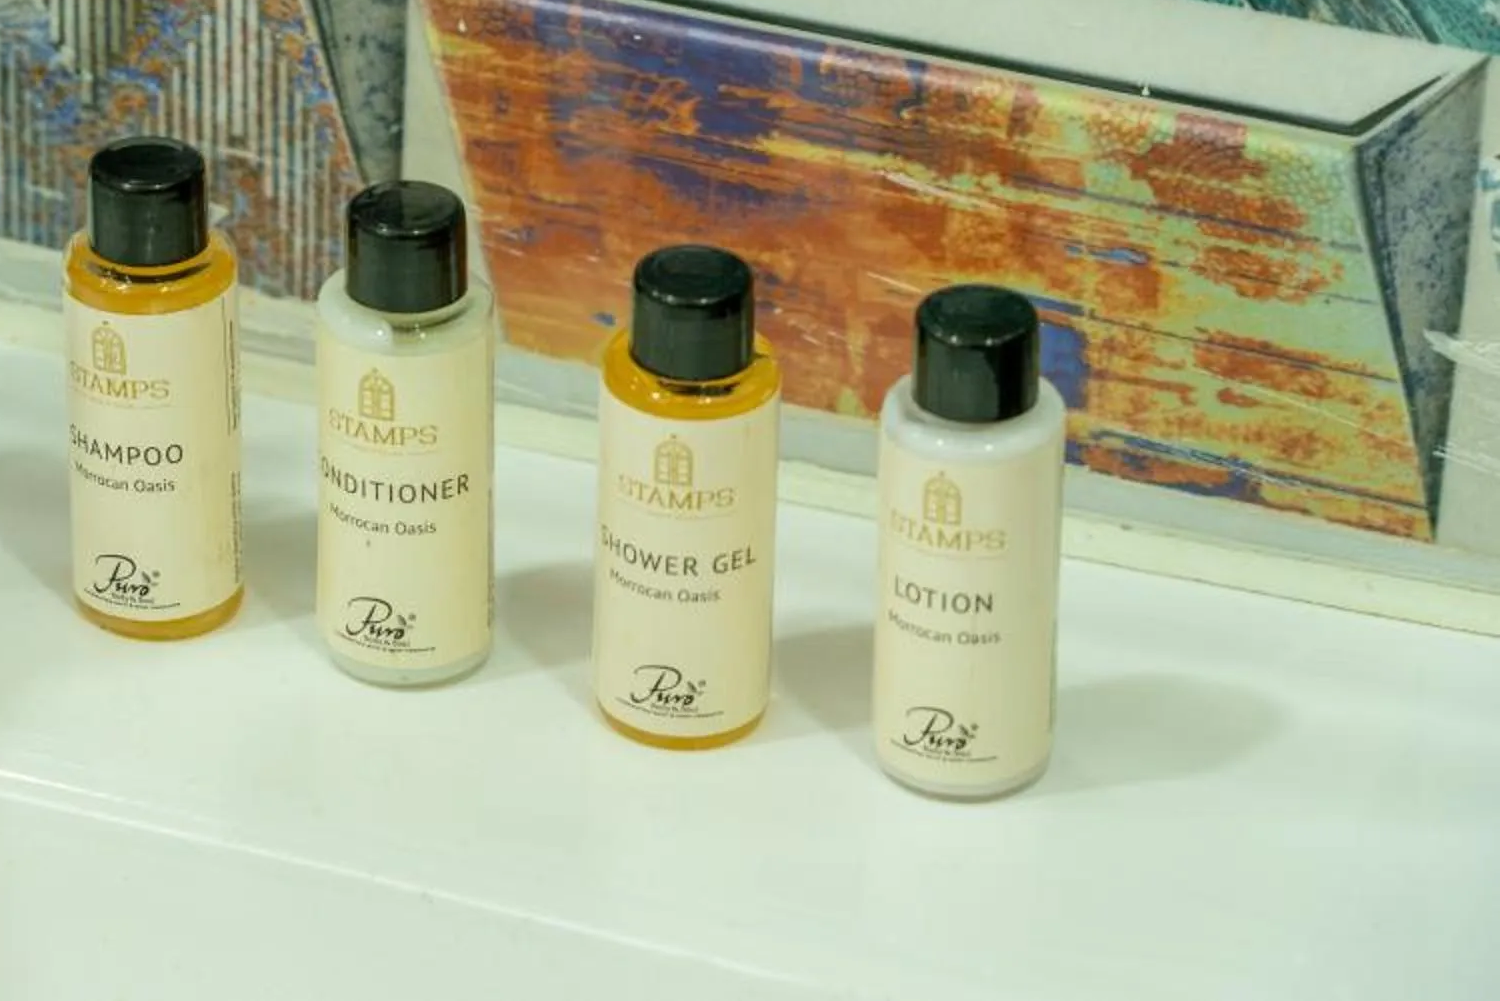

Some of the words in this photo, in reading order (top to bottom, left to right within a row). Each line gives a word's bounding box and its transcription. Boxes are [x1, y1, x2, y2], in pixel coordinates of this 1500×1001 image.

[70, 360, 171, 399] STAMPS
[69, 423, 184, 466] SHAMPOO
[329, 408, 438, 446] STAMPS
[133, 478, 177, 493] Oasis
[320, 456, 470, 504] ONDITIONER
[618, 474, 735, 511] STAMPS
[395, 520, 437, 536] Oasis
[890, 509, 1007, 551] STAMPS
[601, 524, 699, 577] SHOWER
[712, 544, 757, 574] GEL
[677, 586, 722, 603] Oasis
[894, 574, 993, 614] LOTION
[957, 630, 1002, 645] Oasis
